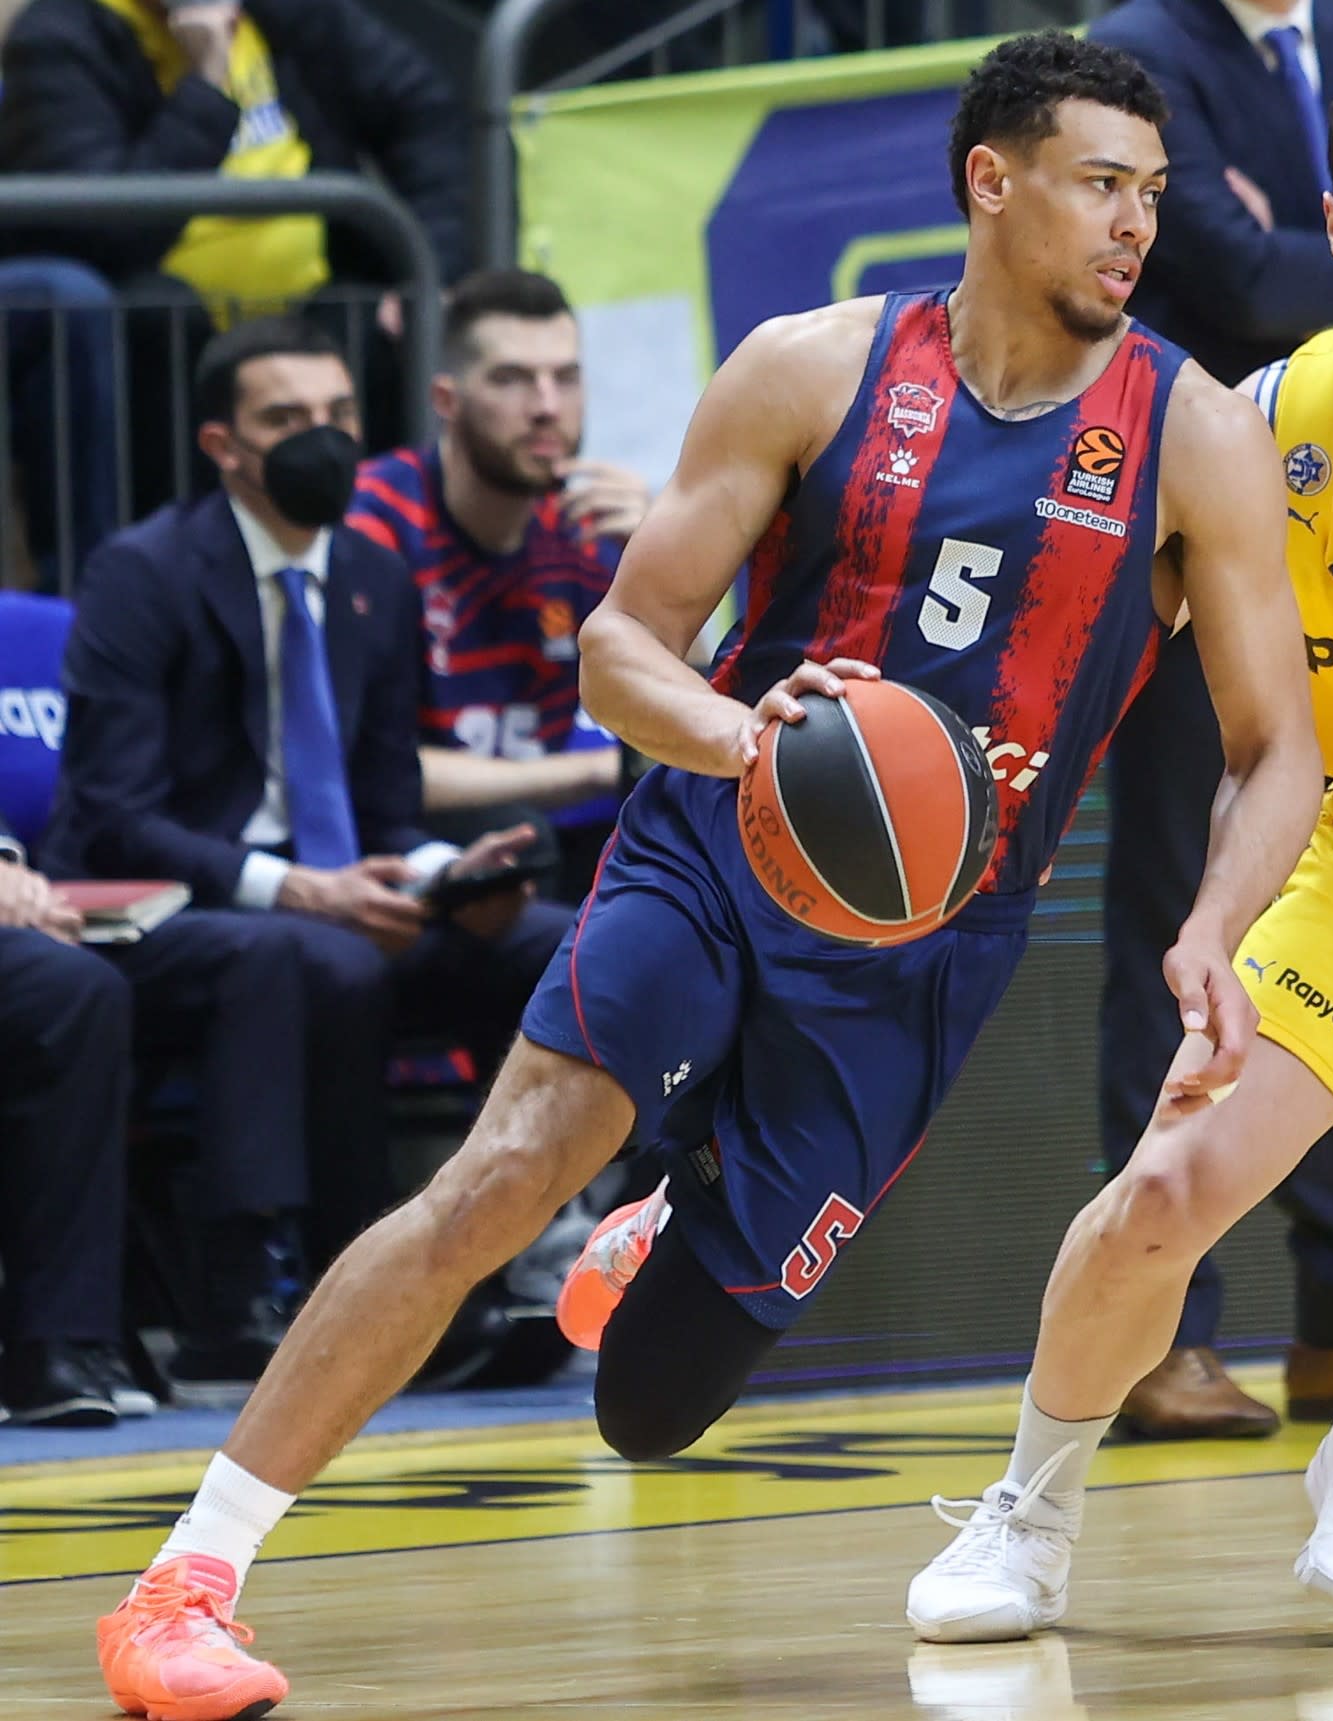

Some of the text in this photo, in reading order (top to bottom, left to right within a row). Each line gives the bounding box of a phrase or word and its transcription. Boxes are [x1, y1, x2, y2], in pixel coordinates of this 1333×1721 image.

[876, 472, 920, 488] KELME
[1069, 479, 1113, 495] AIRLINES
[1072, 470, 1115, 487] TURKISH
[1067, 485, 1111, 502] EuroLeague
[917, 537, 1004, 651] 5
[741, 757, 817, 916] PALDING
[780, 1192, 864, 1300] 5
